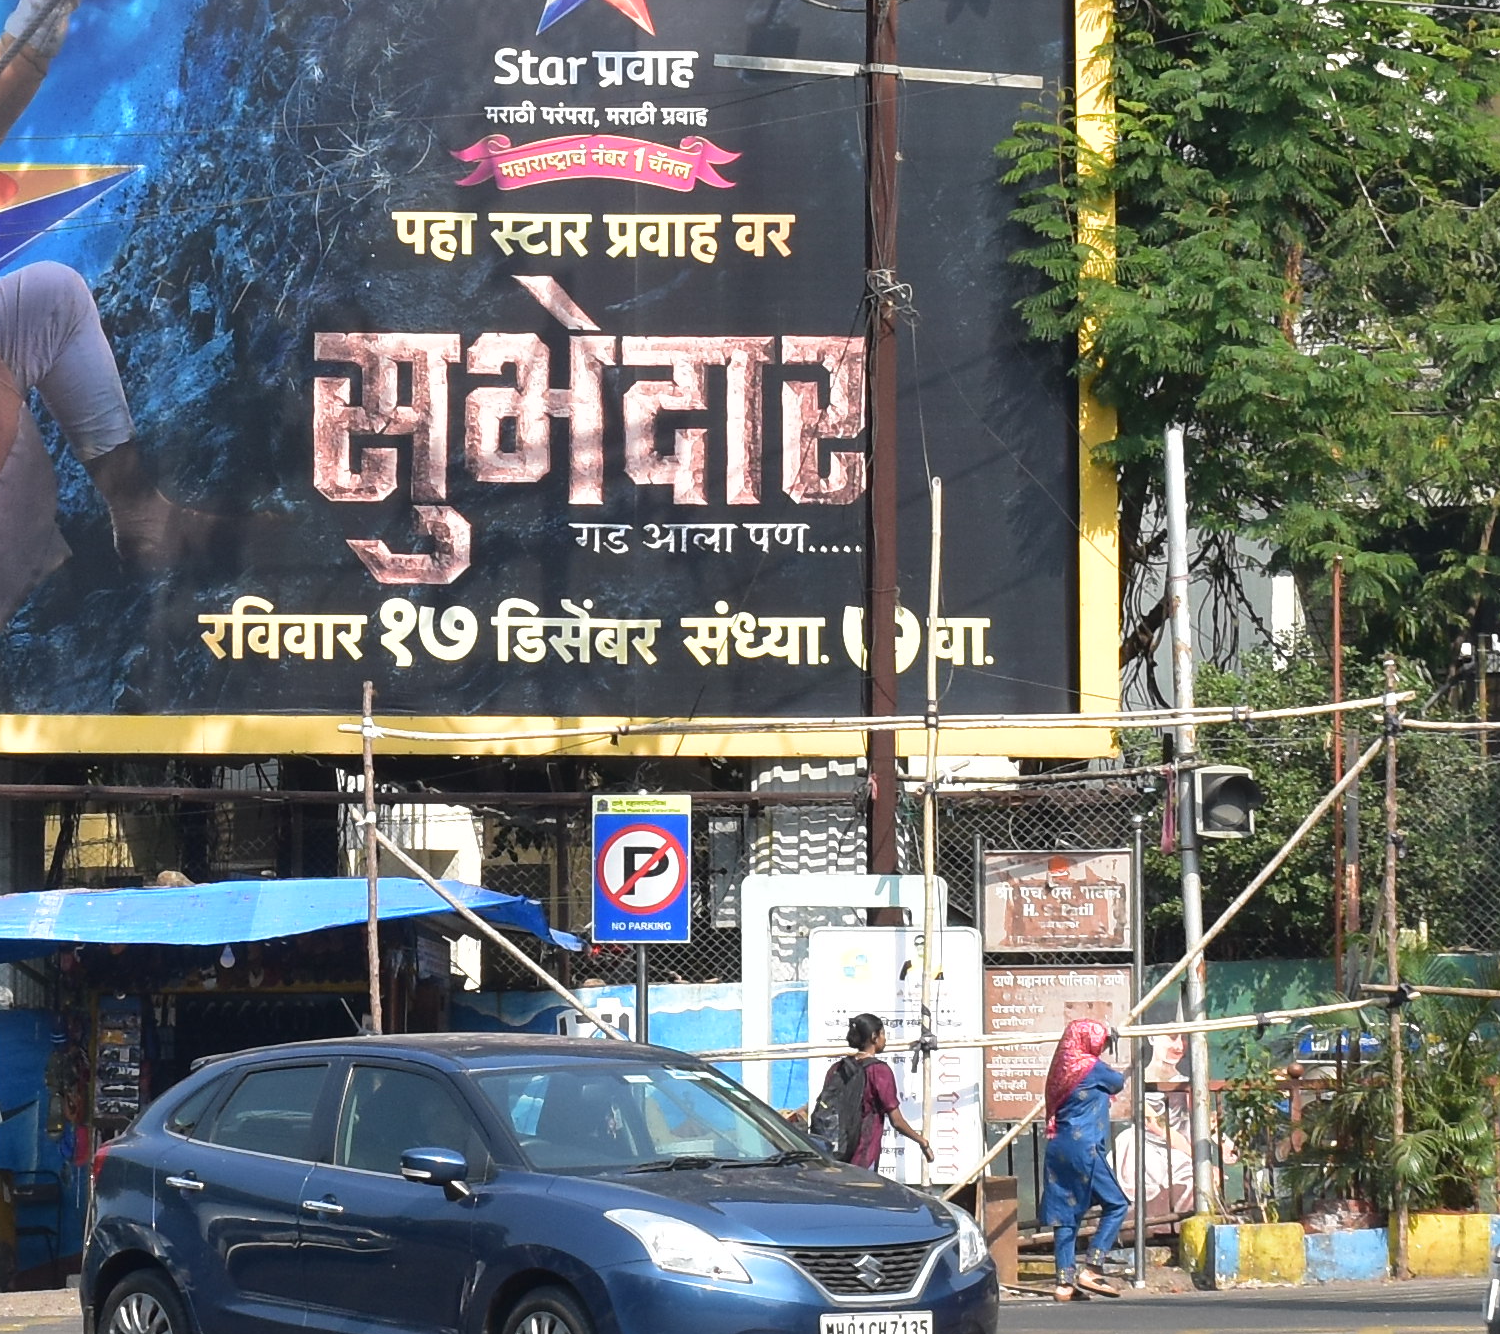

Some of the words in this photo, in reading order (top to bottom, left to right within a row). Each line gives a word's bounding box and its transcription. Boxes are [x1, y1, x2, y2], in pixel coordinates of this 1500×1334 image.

[494, 47, 587, 86] Star
[592, 51, 699, 88] प्रवाह
[484, 101, 537, 125] मराठी
[540, 102, 600, 128] परंपरा,
[605, 101, 657, 126] मराठी
[661, 107, 709, 127] प्रवाह
[498, 144, 587, 178] महाराष्ट्राचं
[591, 144, 628, 168] नंबर
[633, 147, 646, 174] 1
[647, 152, 694, 179] चॅनल
[392, 210, 475, 259] पहा
[487, 210, 590, 257] स्टार
[603, 210, 719, 259] प्रवाह
[732, 211, 795, 257] वर
[312, 274, 867, 585] सुभेदार
[568, 522, 633, 555] गड
[642, 522, 738, 555] आला
[198, 595, 368, 662] रविवार
[378, 595, 478, 667] १७
[491, 595, 661, 665] डिसेंबर
[681, 598, 830, 665] संध्या.
[611, 921, 627, 931] NO
[628, 921, 672, 931] PARKING
[992, 971, 1014, 987] ठाणे
